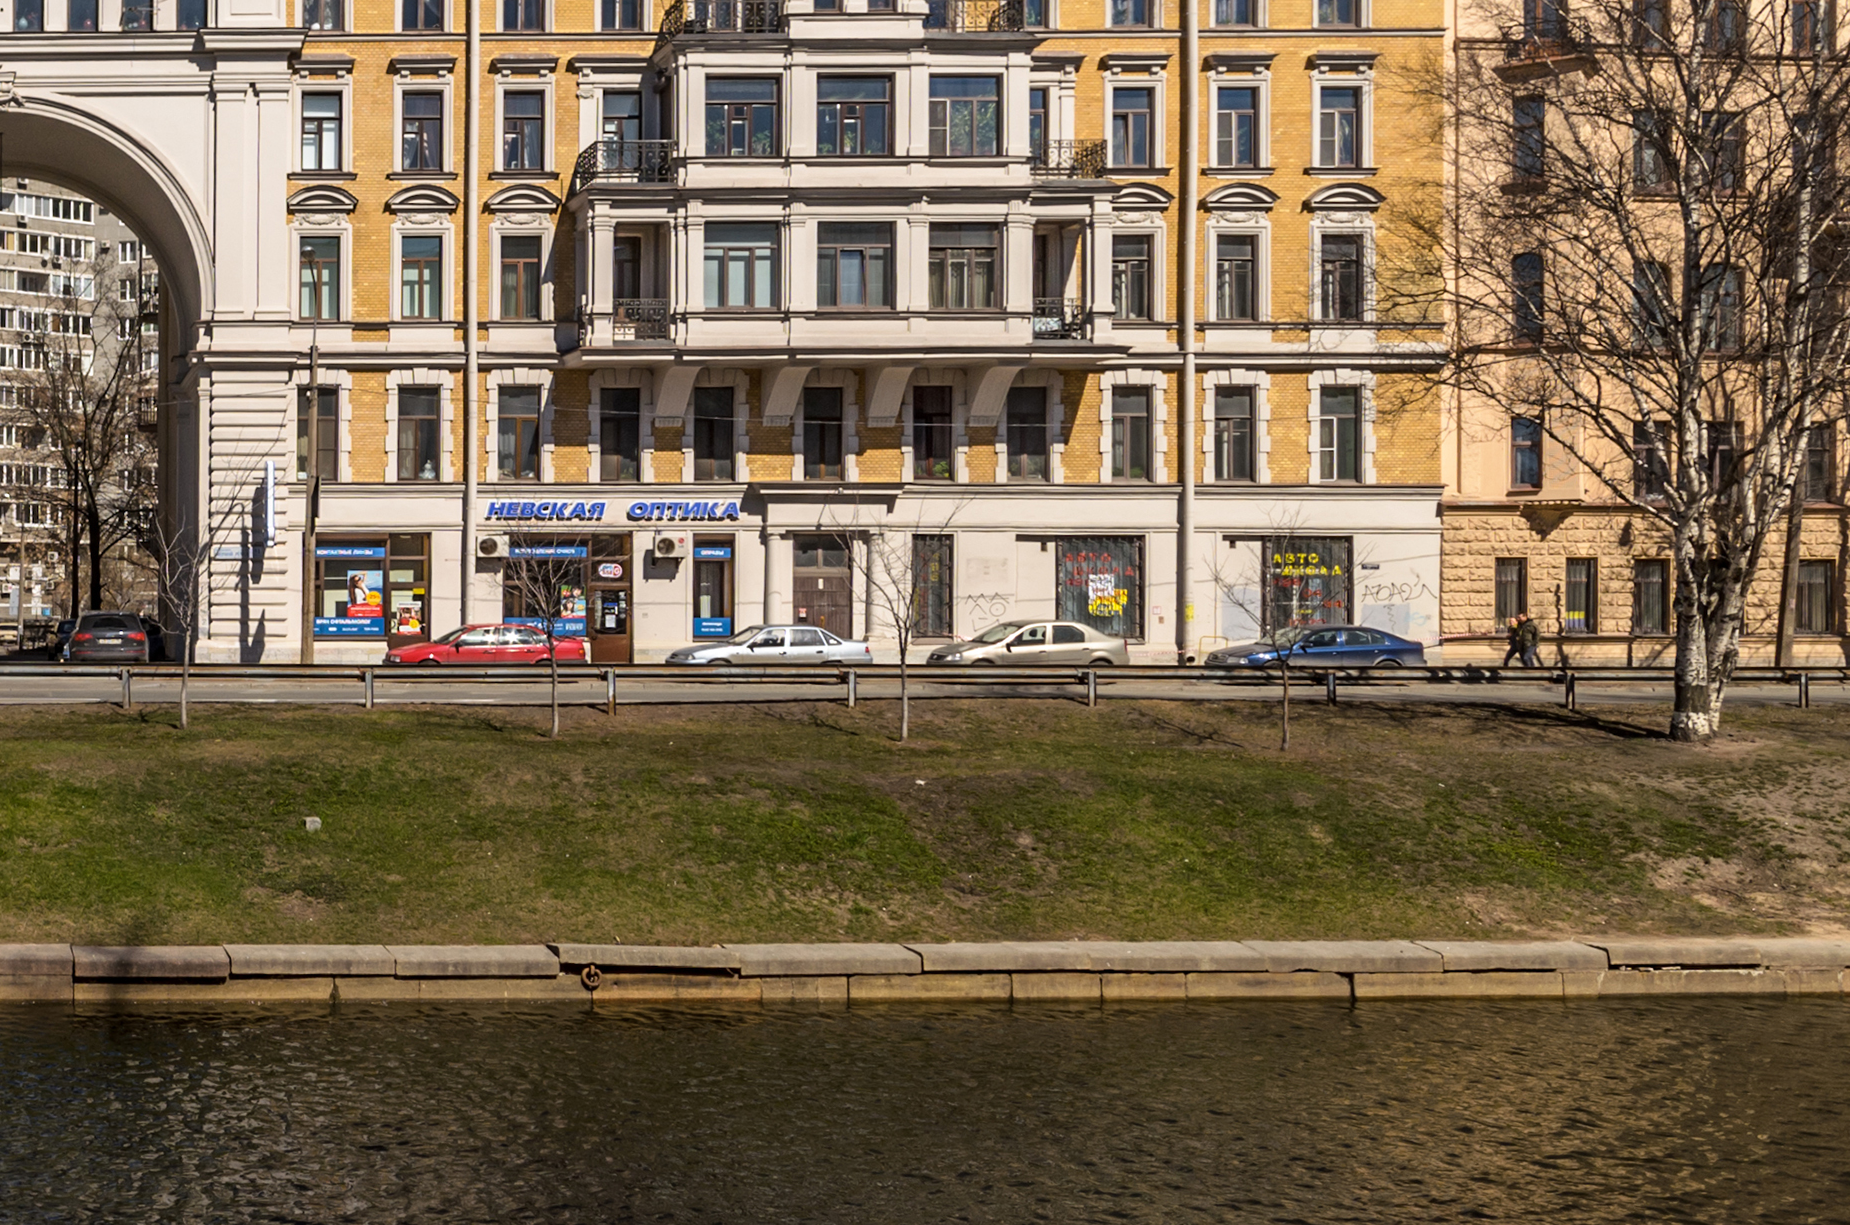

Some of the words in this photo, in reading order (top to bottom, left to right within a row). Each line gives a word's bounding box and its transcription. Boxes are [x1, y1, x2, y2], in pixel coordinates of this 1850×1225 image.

[486, 502, 606, 518] НЕВСКАЯ
[628, 502, 740, 518] ОПТИКА
[1273, 553, 1319, 564] АВТО
